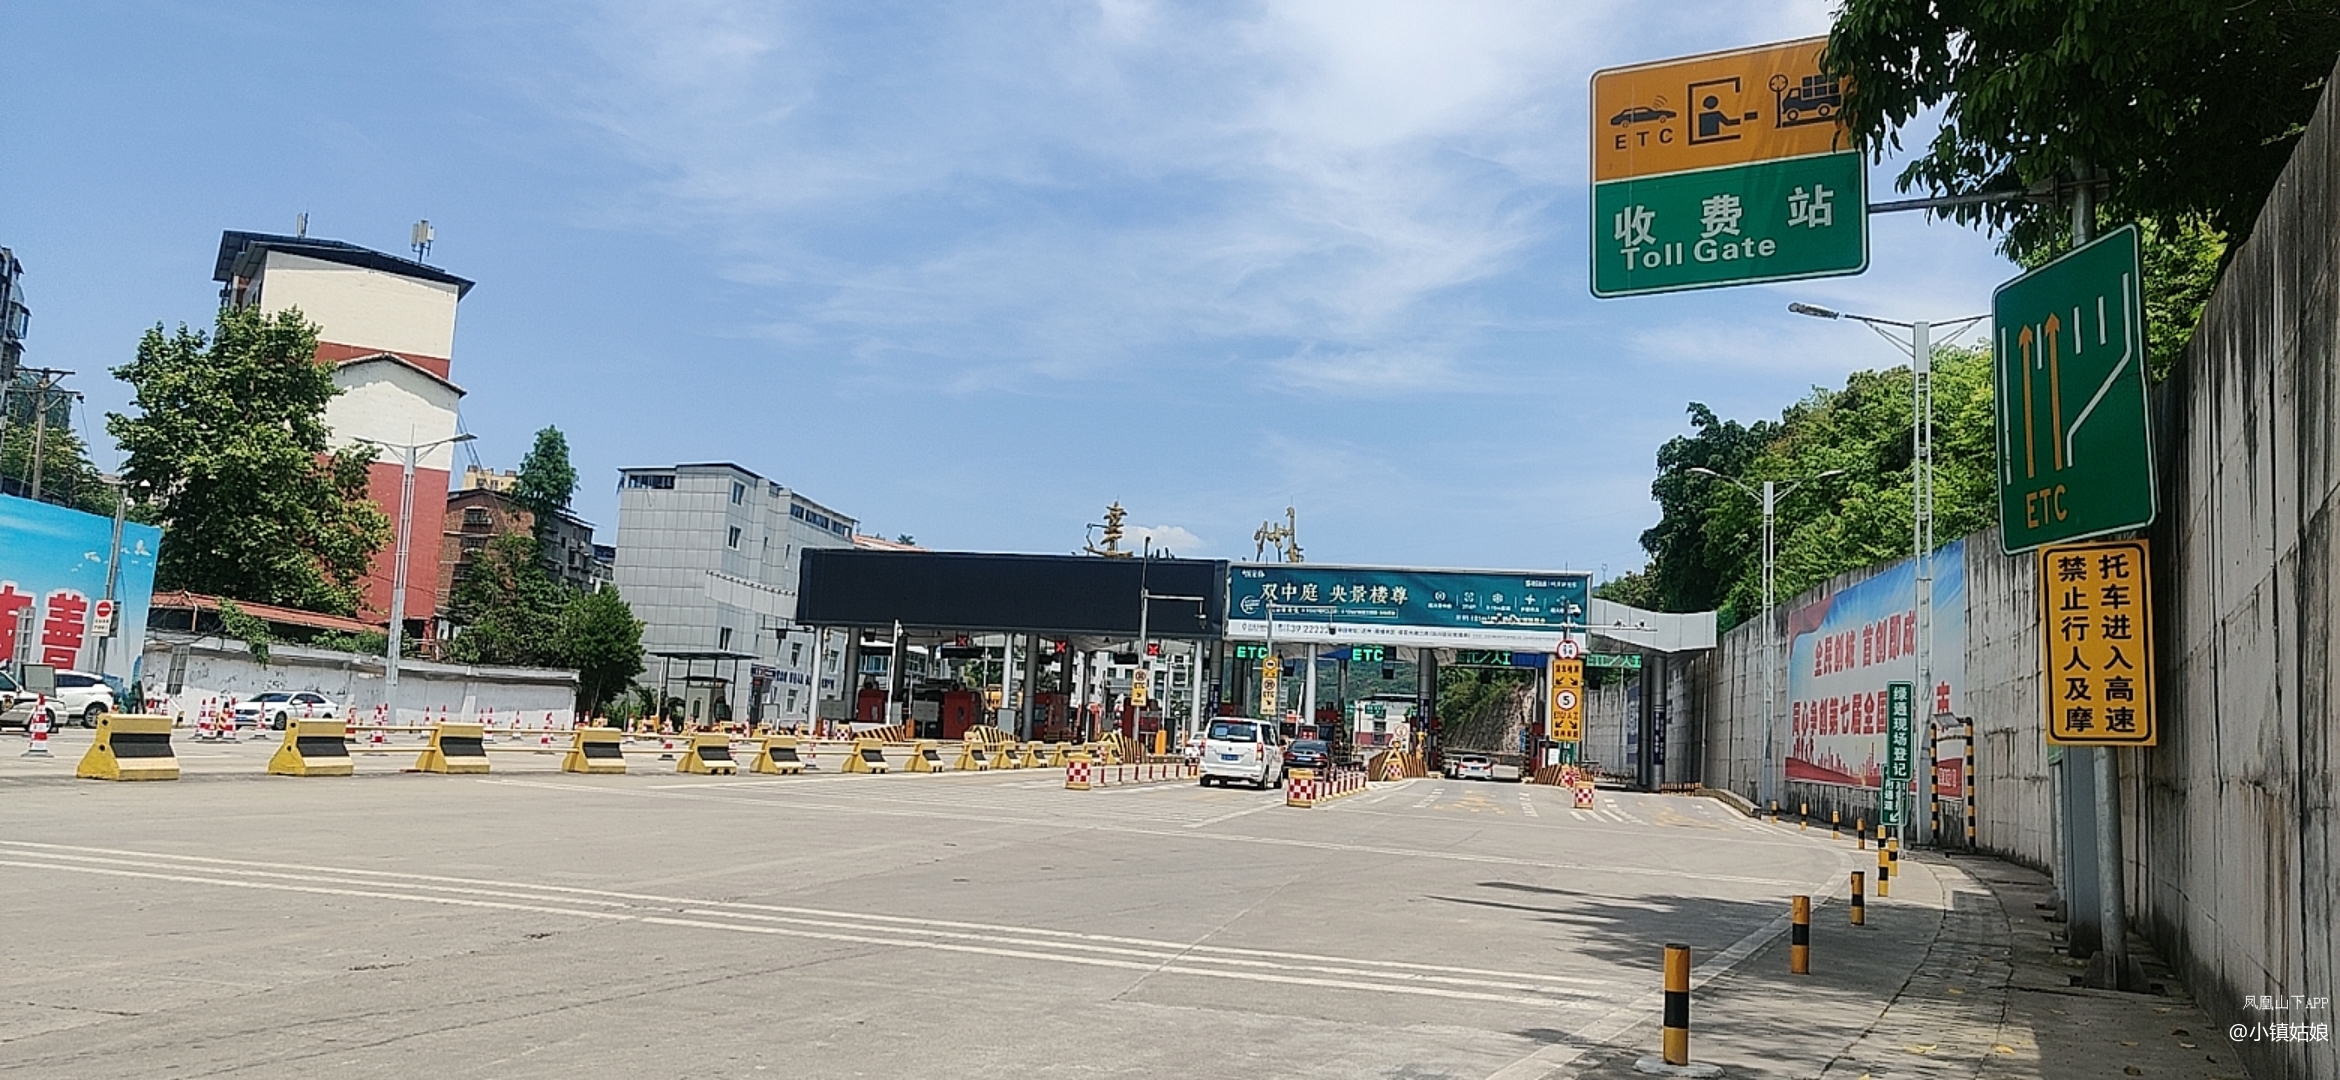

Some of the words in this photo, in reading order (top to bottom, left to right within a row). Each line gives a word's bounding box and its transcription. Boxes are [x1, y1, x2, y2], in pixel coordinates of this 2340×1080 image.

[1614, 128, 1674, 150] ETC
[1613, 184, 1835, 247] 收费站
[1620, 242, 1684, 271] Toll
[1693, 237, 1777, 263] Gate
[2026, 484, 2069, 530] ETC
[1260, 583, 1319, 603] 双中庭
[1236, 645, 1269, 659] ETC
[1352, 648, 1384, 662] ETC
[2057, 555, 2095, 733] 禁止行人及摩
[2098, 553, 2136, 733] 托车进入高速
[1562, 695, 1570, 706] 5
